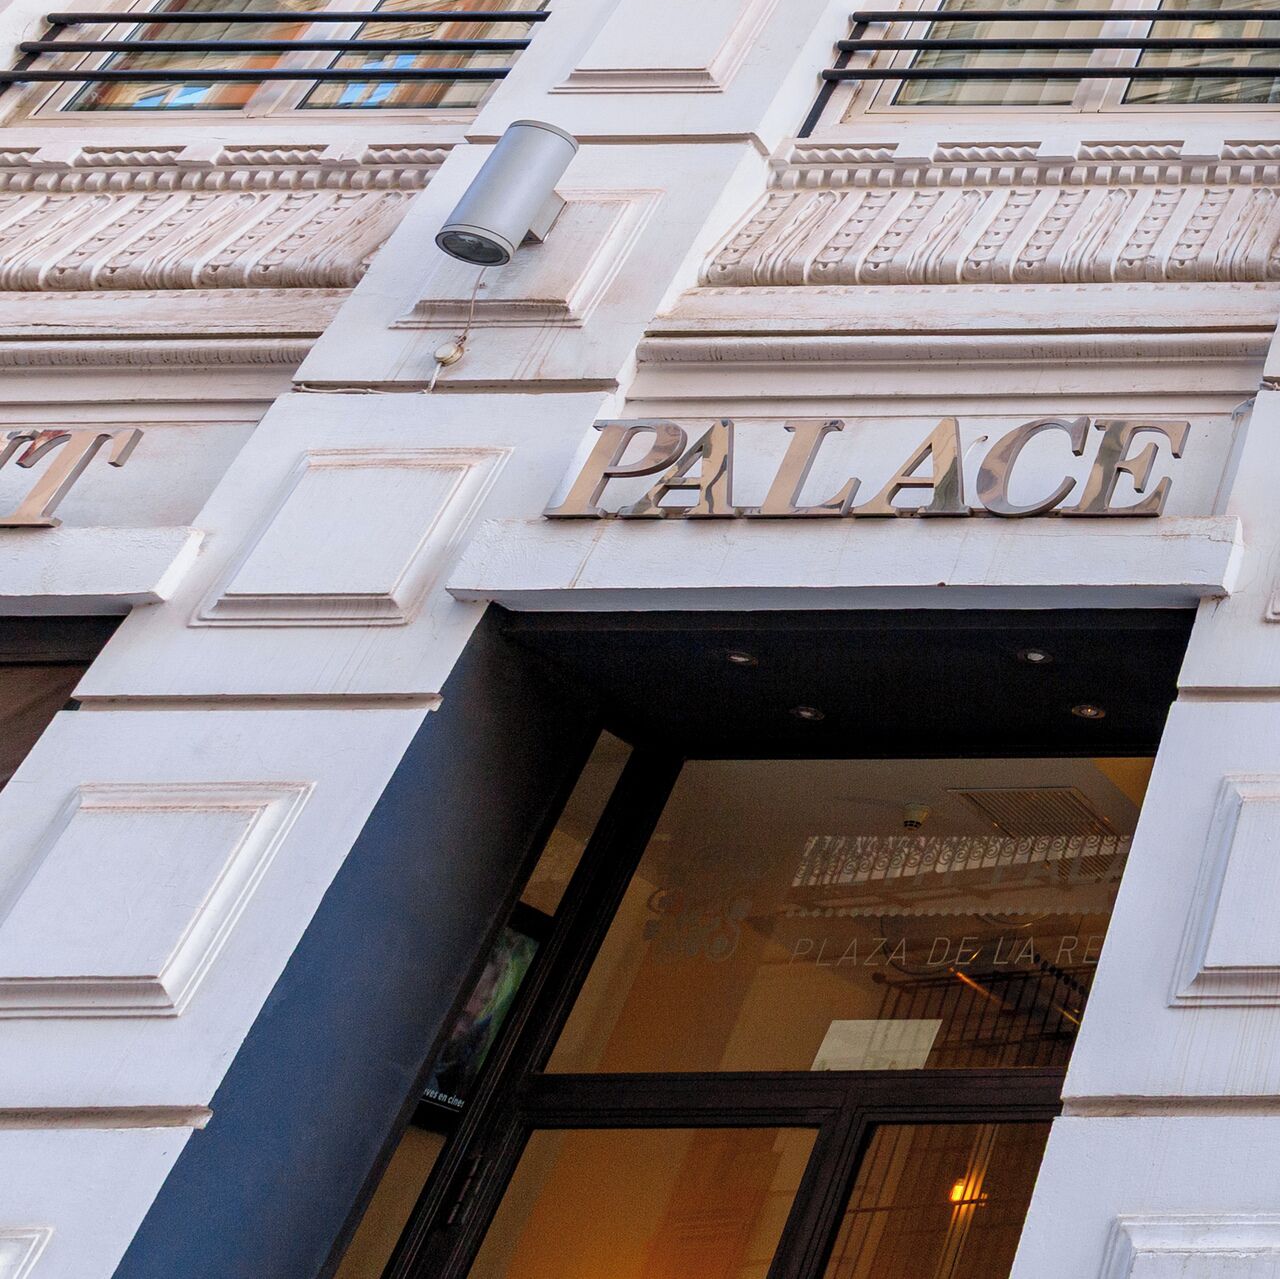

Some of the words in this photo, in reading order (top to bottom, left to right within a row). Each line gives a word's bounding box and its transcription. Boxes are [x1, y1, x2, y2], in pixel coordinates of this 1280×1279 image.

[543, 416, 1191, 520] PALACE
[789, 937, 907, 966] PLAZA
[926, 936, 978, 966] DE
[992, 936, 1035, 965] LA
